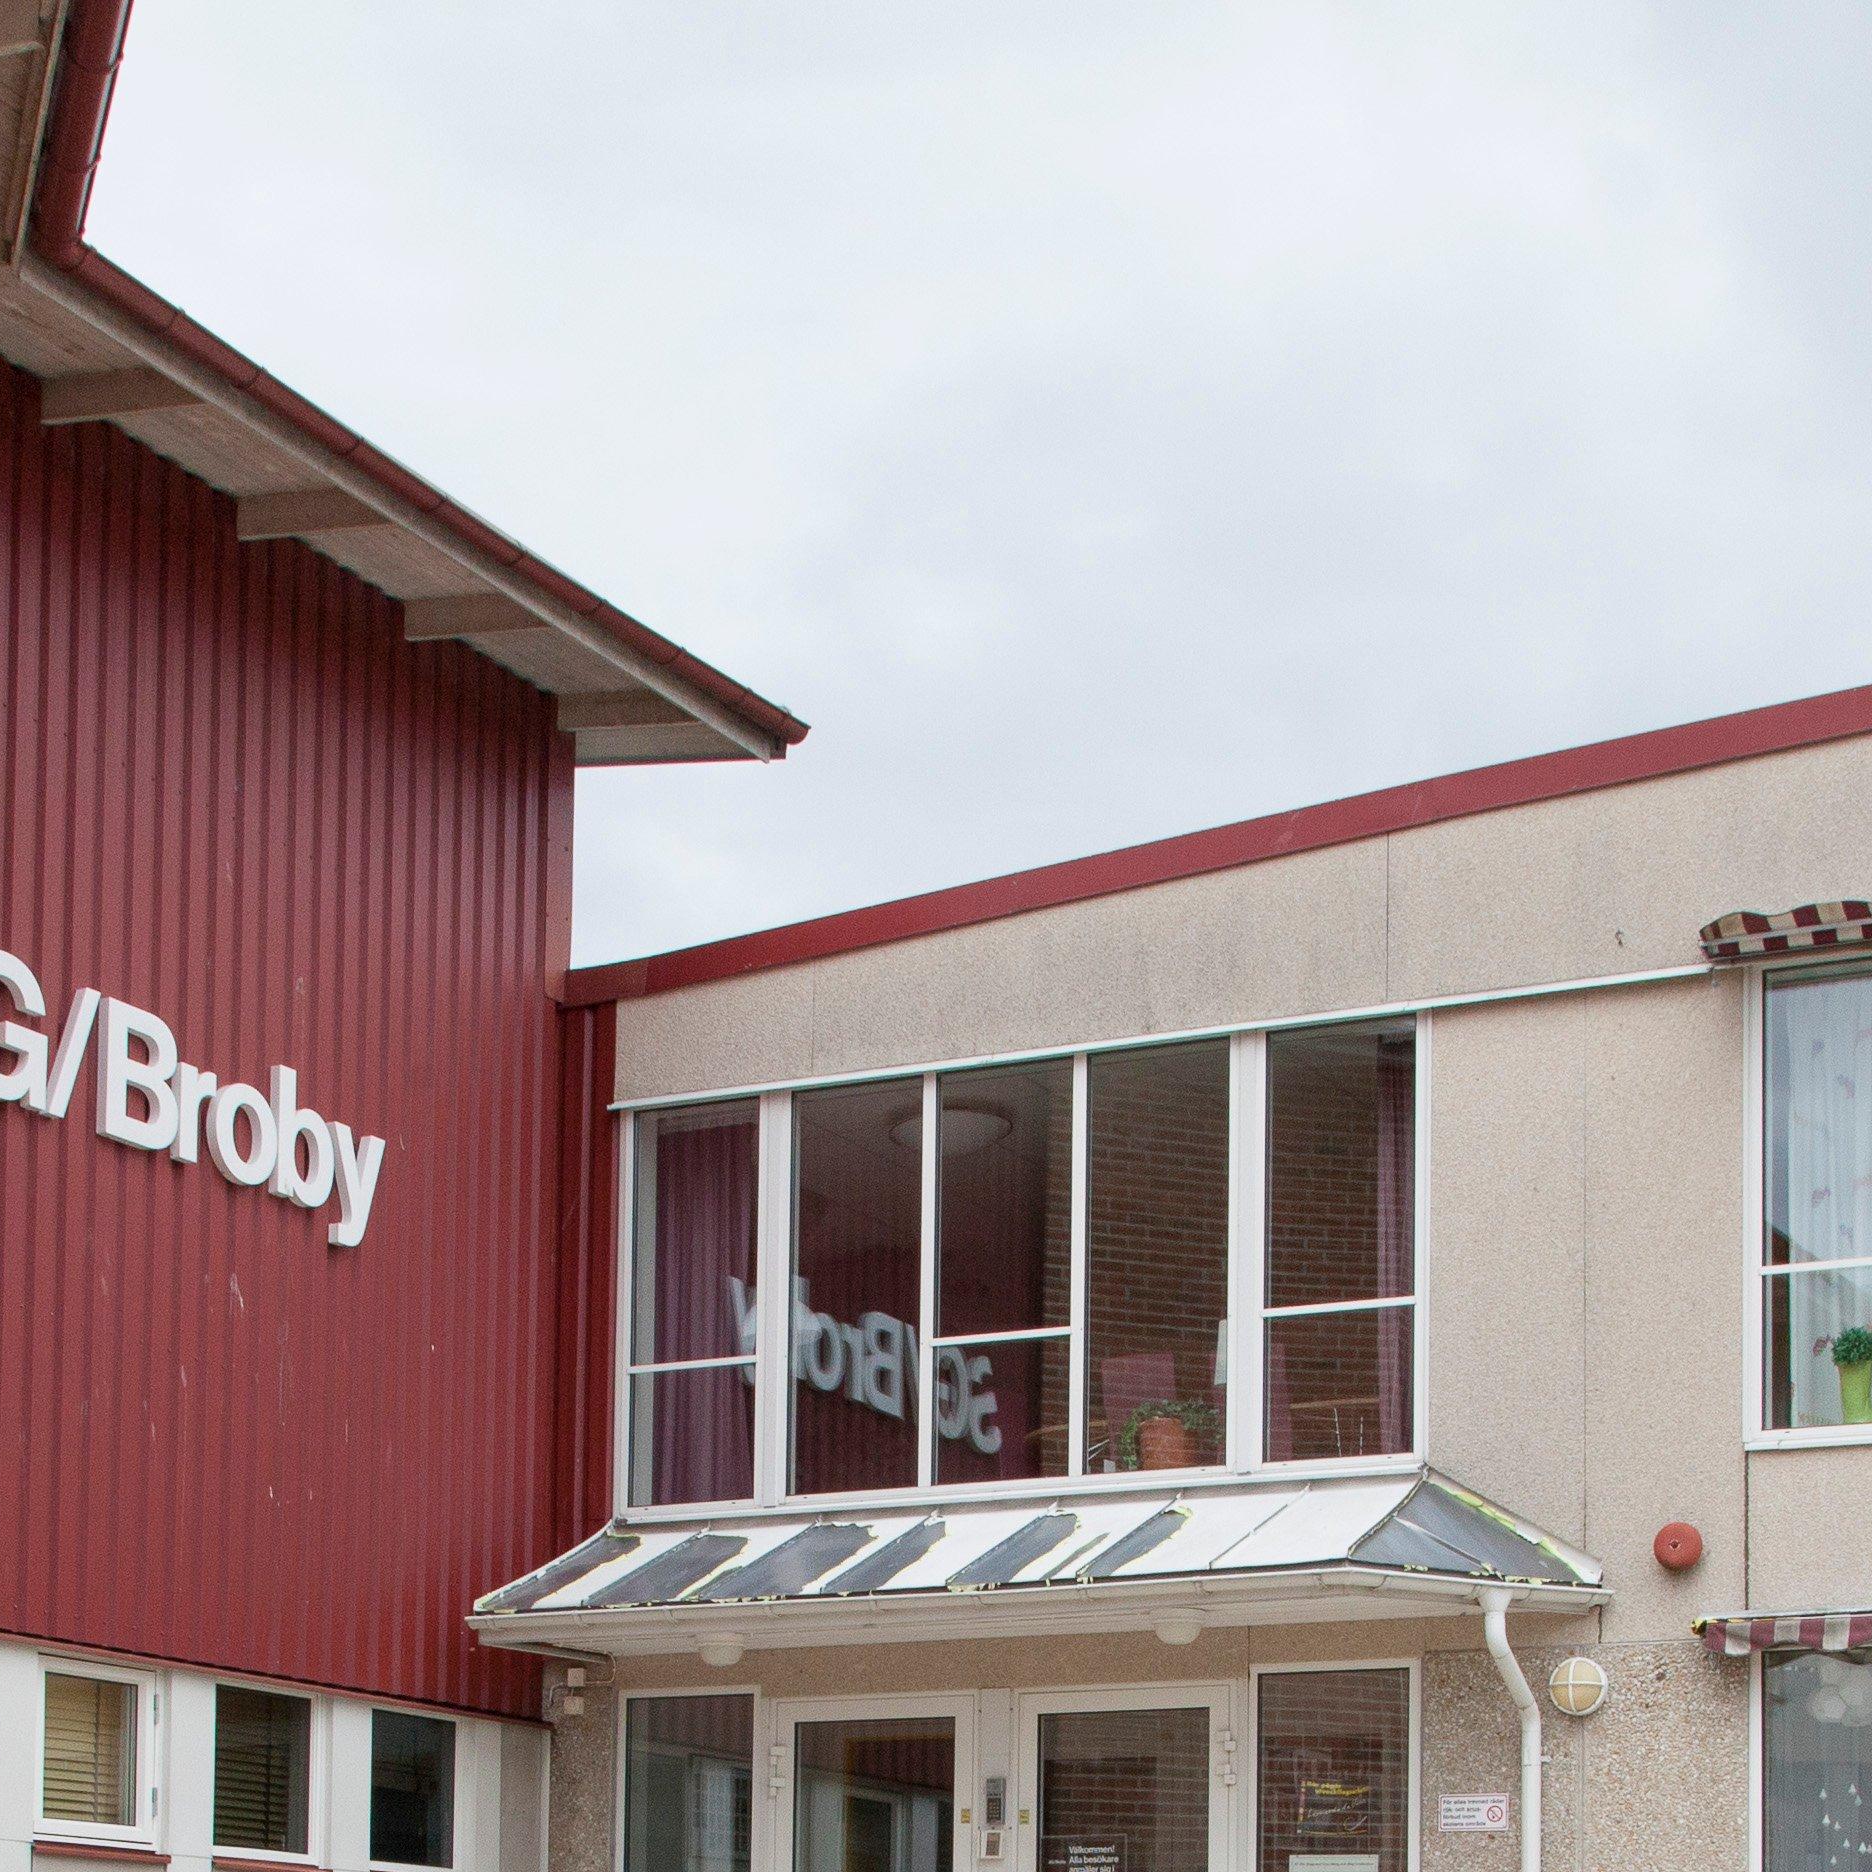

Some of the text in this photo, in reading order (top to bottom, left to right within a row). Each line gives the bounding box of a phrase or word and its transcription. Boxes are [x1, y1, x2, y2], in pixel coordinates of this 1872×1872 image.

[1069, 1845, 1115, 1854] Välkommen!
[1069, 1855, 1083, 1864] Alla
[1083, 1855, 1119, 1864] besökare
